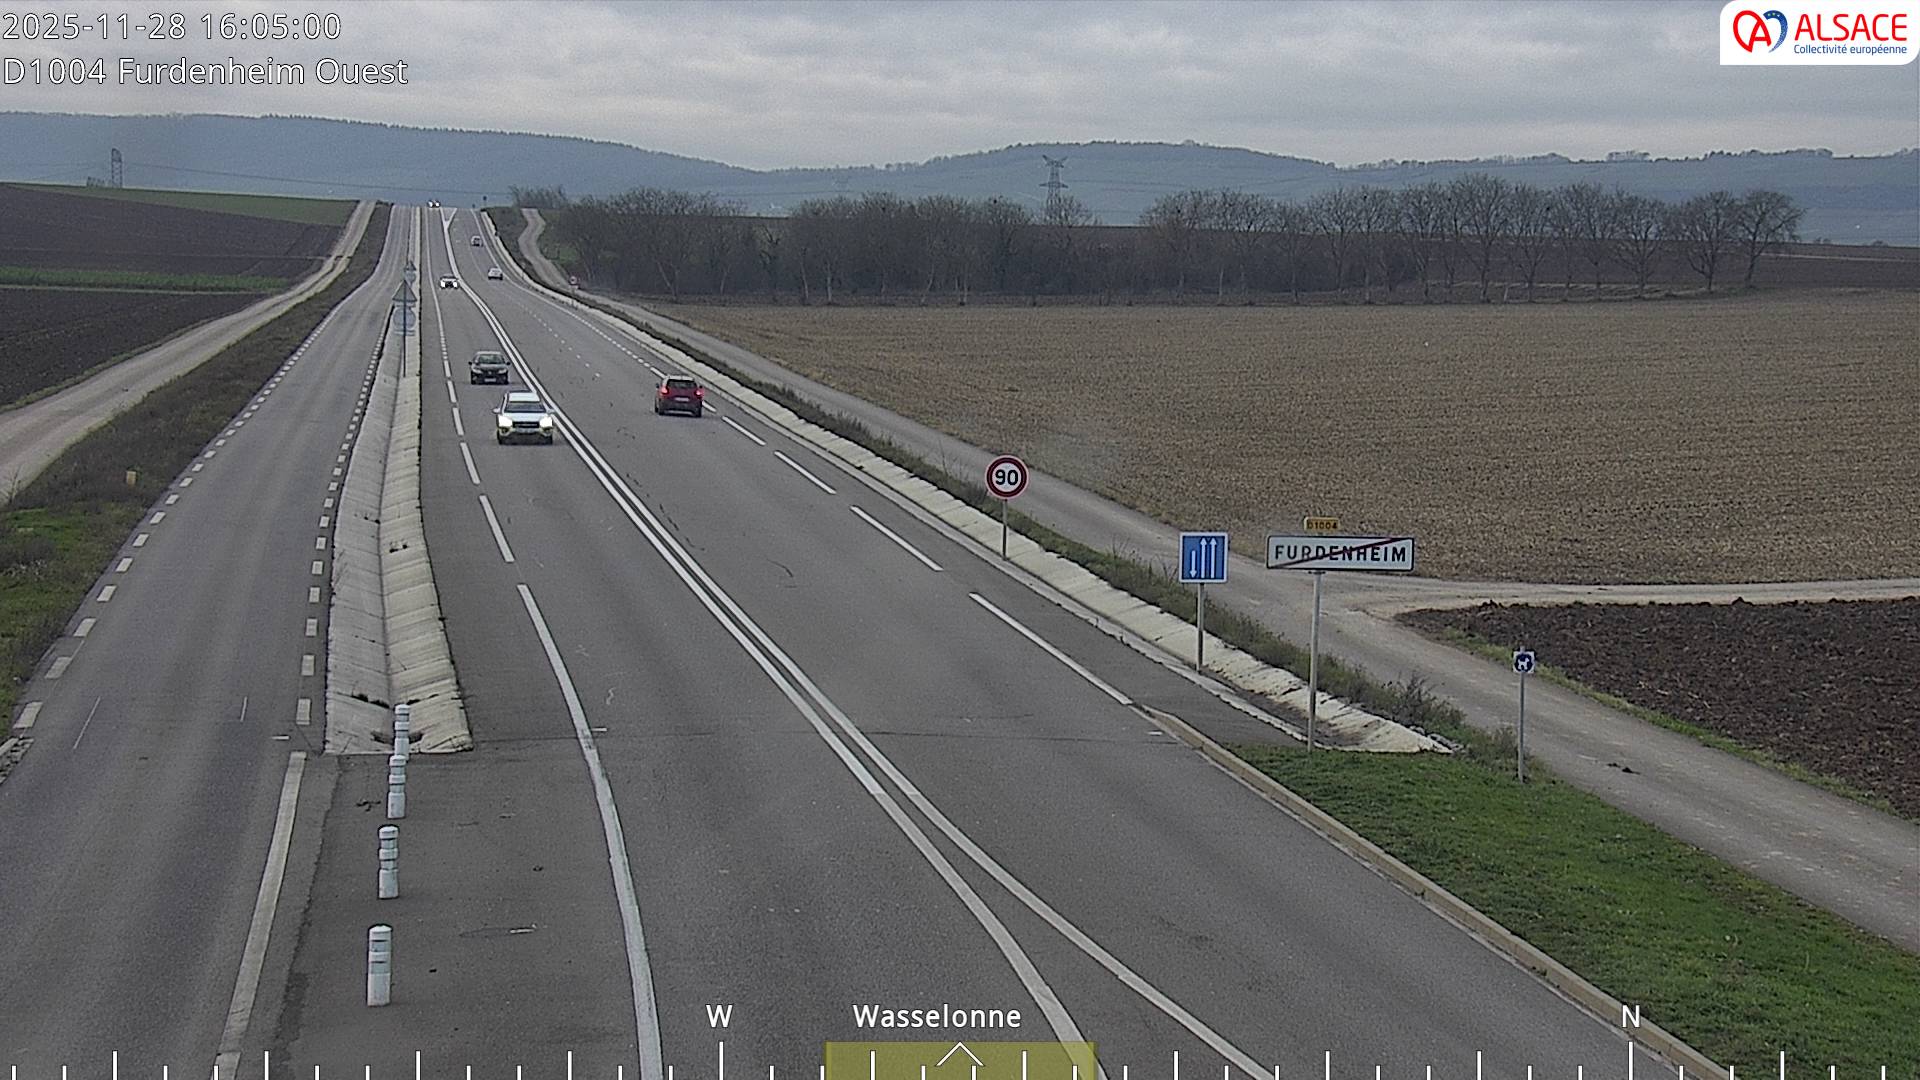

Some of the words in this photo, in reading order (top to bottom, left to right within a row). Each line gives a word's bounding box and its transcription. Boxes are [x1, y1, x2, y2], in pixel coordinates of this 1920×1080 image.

[995, 469, 1019, 486] 90
[1307, 522, 1338, 530] D1004
[1275, 545, 1406, 562] FURDENHEIM
